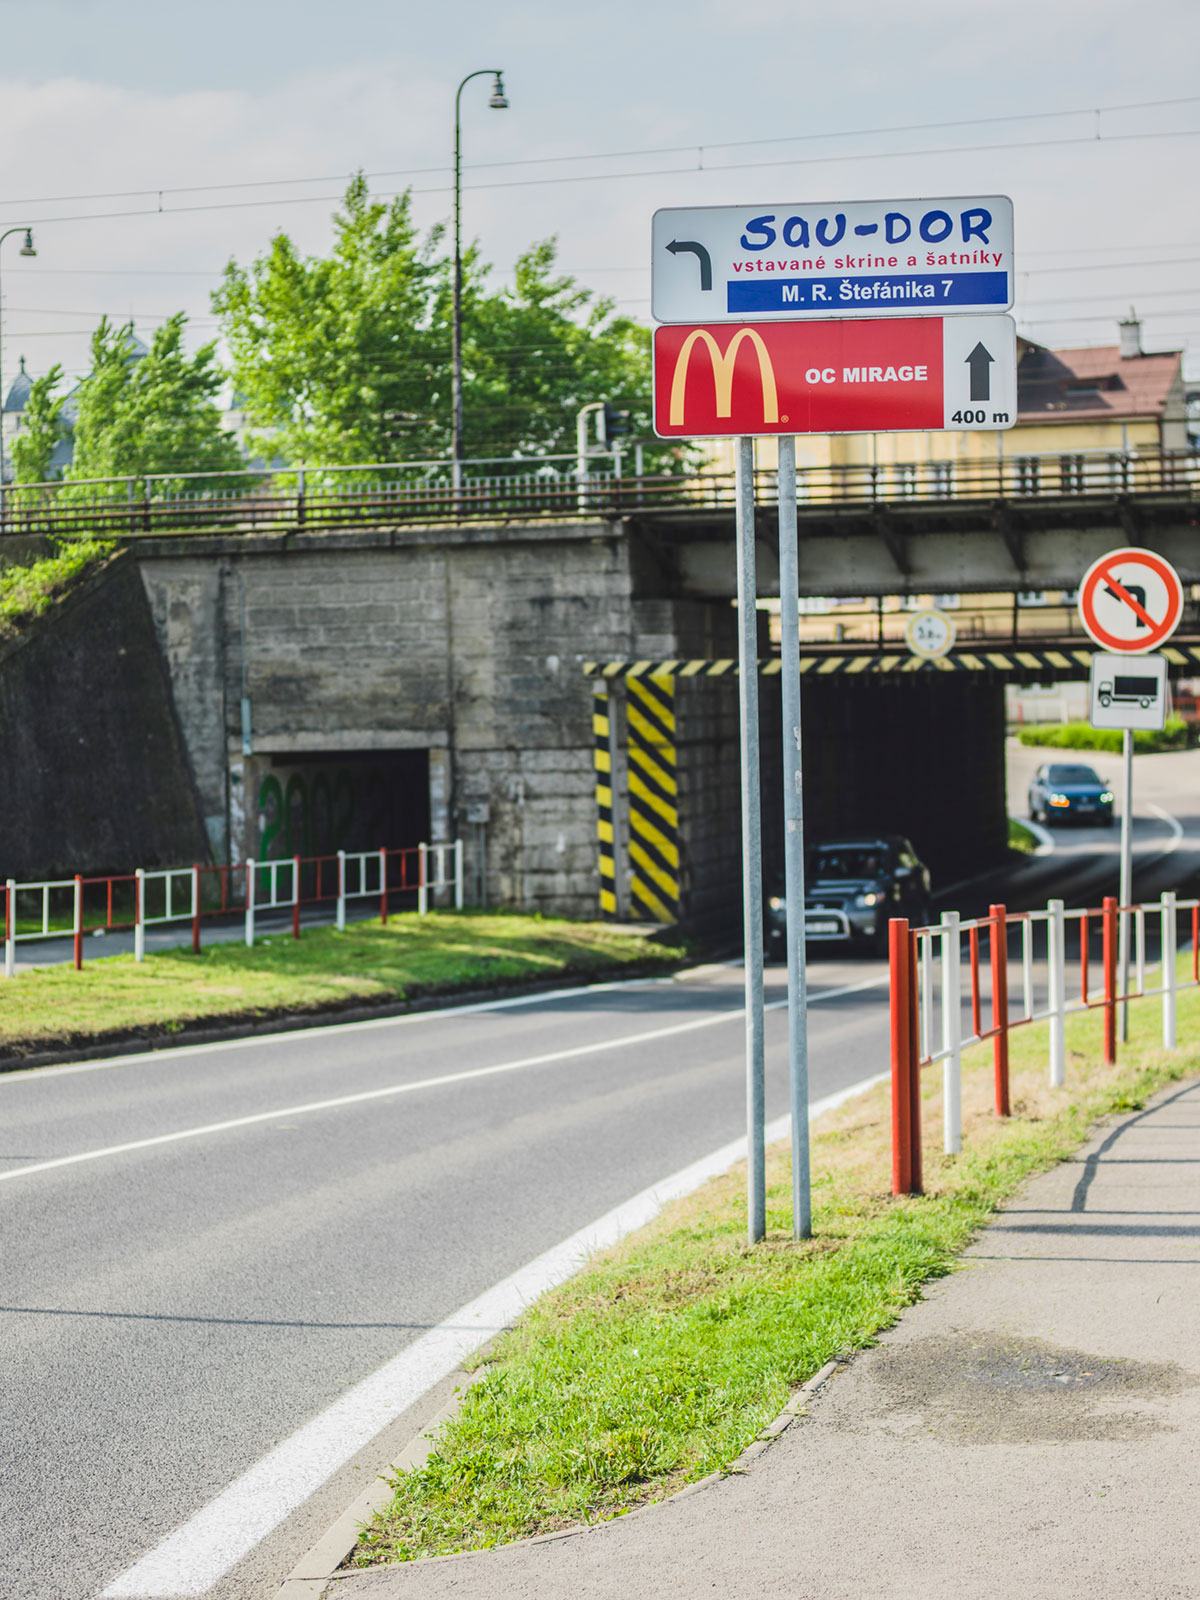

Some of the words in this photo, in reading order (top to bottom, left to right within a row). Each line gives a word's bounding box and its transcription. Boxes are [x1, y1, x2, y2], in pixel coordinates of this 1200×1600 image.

[732, 256, 826, 272] vstavané
[834, 254, 898, 269] skrine
[907, 255, 917, 267] a
[926, 250, 1003, 267] šatníky
[782, 285, 805, 302] M.
[812, 284, 833, 301] R.
[839, 279, 935, 300] Štefánika
[941, 280, 954, 297] 7
[805, 368, 836, 384] OC
[843, 365, 928, 383] MIRAGE
[951, 410, 986, 424] 400
[992, 411, 1010, 423] m
